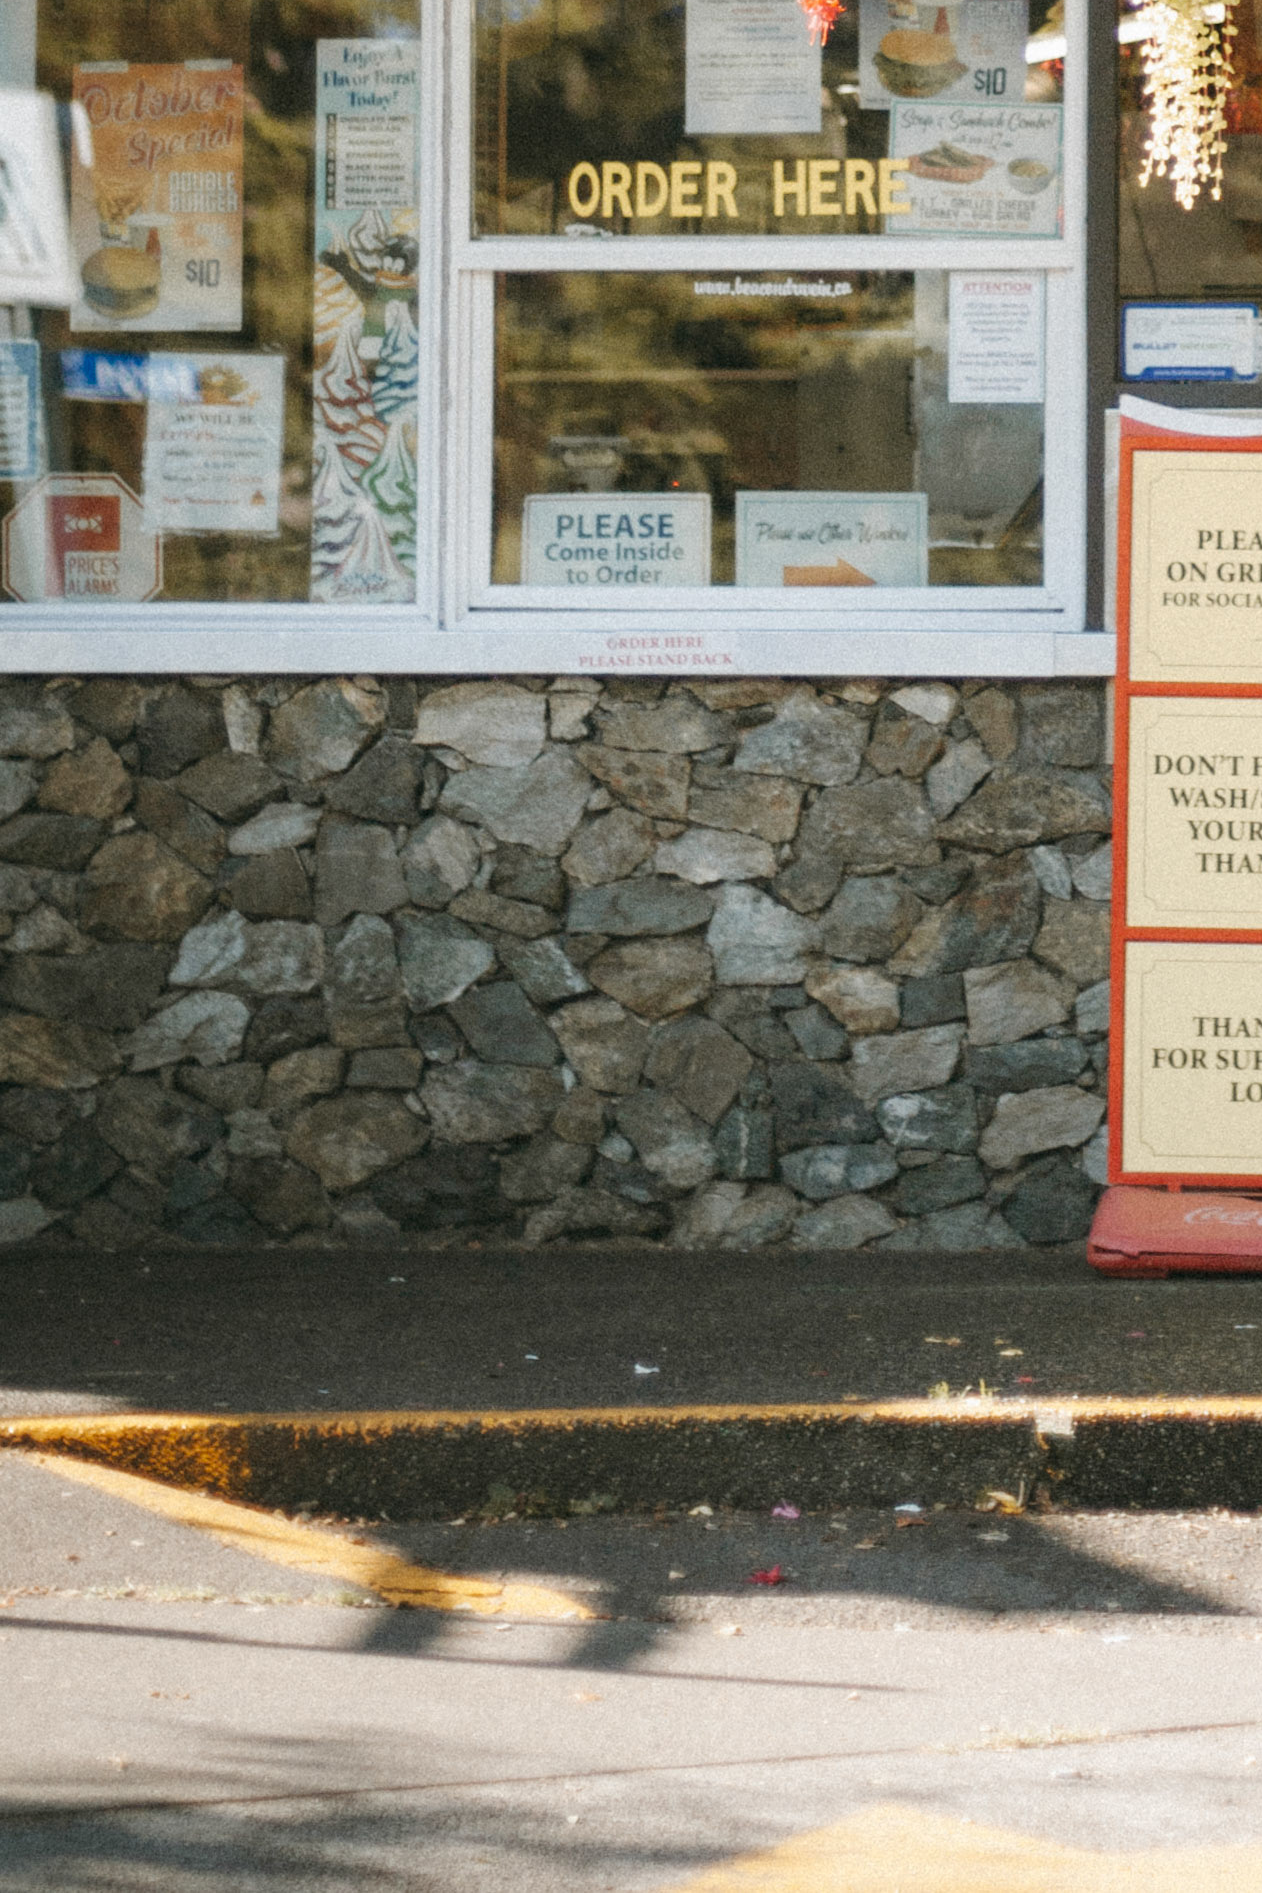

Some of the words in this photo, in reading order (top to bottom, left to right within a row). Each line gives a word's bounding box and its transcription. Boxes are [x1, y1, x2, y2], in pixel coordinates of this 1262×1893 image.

[973, 67, 1008, 96] $10
[80, 73, 241, 128] October
[128, 114, 235, 170] Special
[568, 160, 738, 218] ORDER
[773, 158, 913, 217] HERE
[185, 258, 220, 288] $10
[963, 281, 1033, 293] ATTENTION
[556, 513, 674, 539] PLEASE
[755, 521, 793, 542] Please
[545, 543, 609, 563] Come
[615, 542, 685, 562] Inside
[67, 556, 121, 576] PRICE'S
[566, 567, 590, 585] to
[596, 565, 663, 585] Order
[1167, 561, 1208, 583] ON
[65, 578, 121, 596] ALARMS
[1162, 592, 1200, 607] FOR
[606, 637, 661, 651] ORDER
[664, 636, 705, 649] HERE
[579, 655, 636, 668] PLEASE
[637, 654, 690, 667] STAND
[691, 653, 733, 666] BACK
[1154, 754, 1244, 777] DON'T
[1152, 1048, 1208, 1070] FOR
